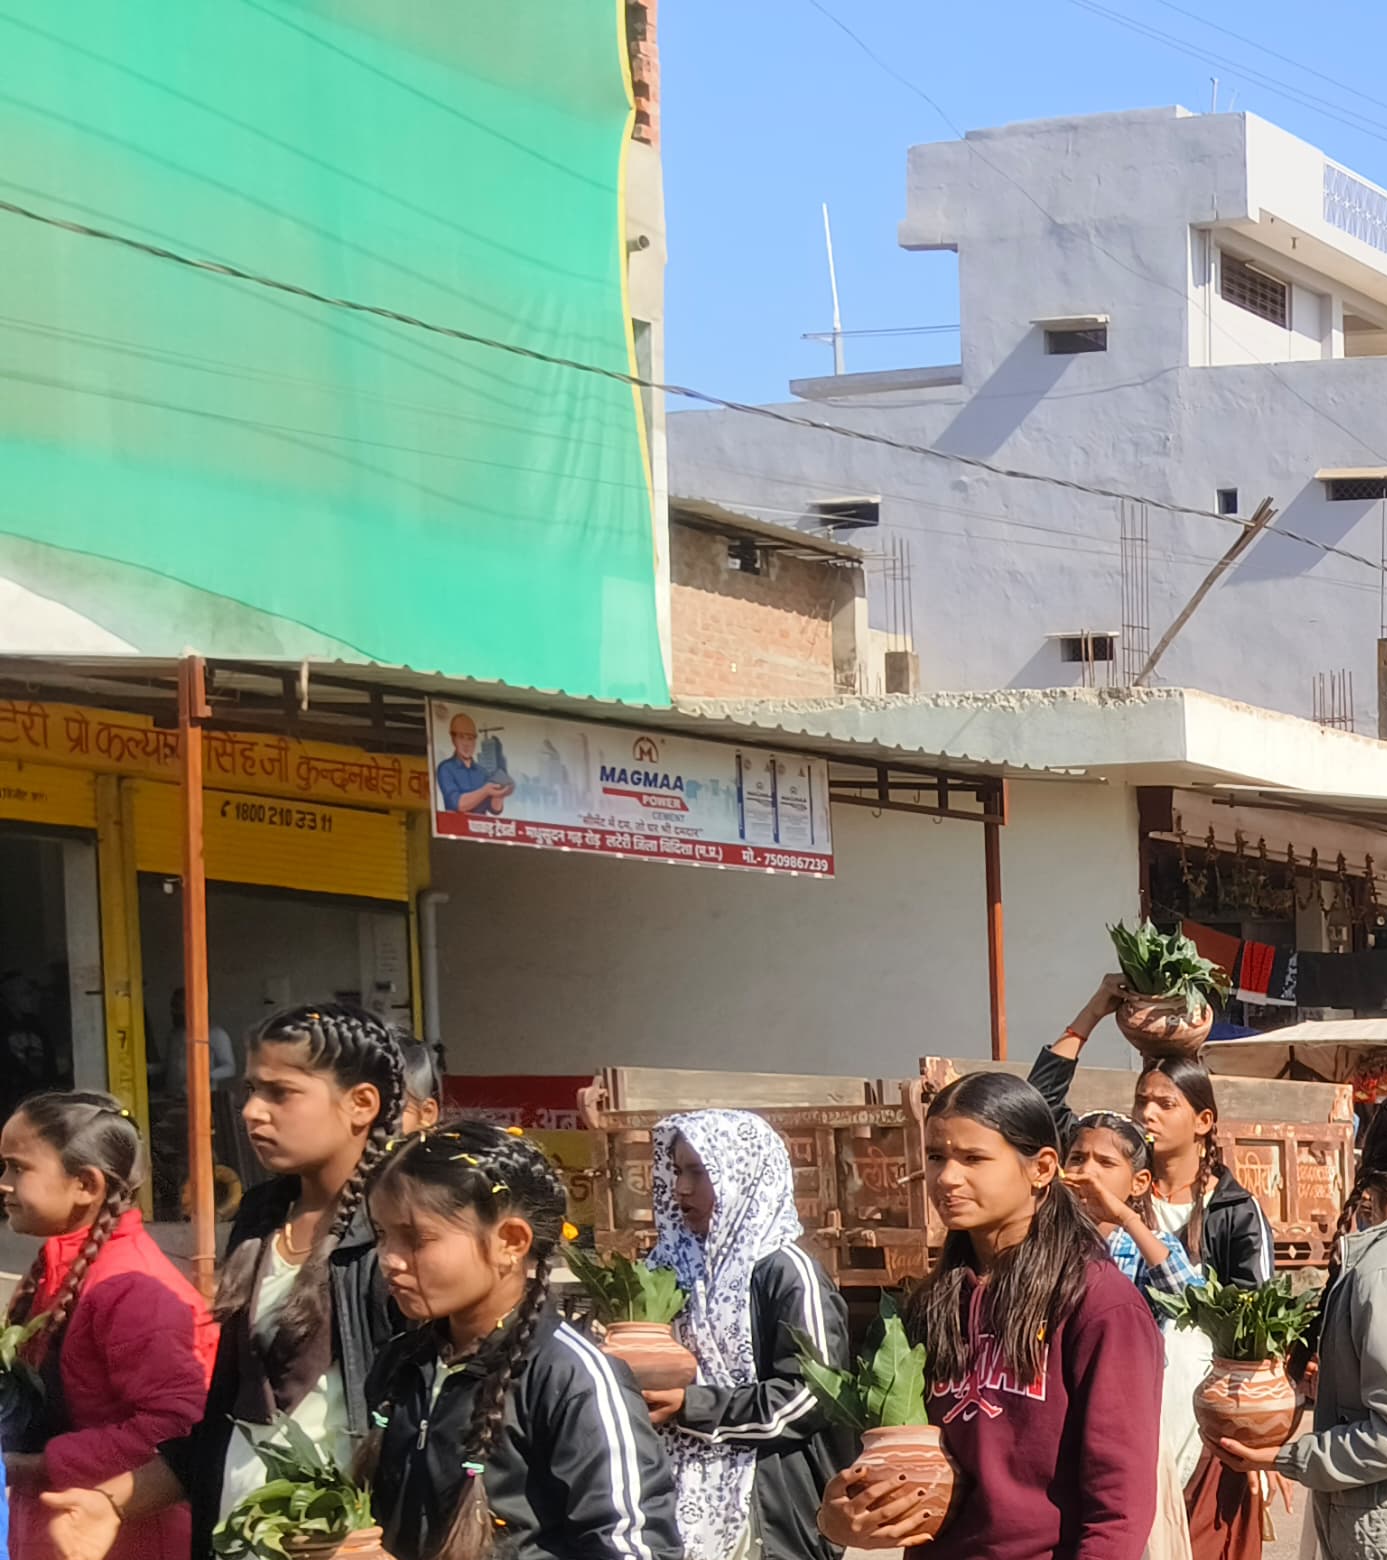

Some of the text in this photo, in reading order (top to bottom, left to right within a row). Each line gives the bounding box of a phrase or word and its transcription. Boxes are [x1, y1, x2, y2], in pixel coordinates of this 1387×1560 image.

[0, 700, 50, 749] टेरी
[600, 765, 684, 791] MAGMAA
[642, 795, 682, 810] POWER
[235, 803, 265, 823] 1800
[268, 806, 292, 826] 210
[296, 810, 317, 830] 33
[764, 853, 828, 872] 7509867239
